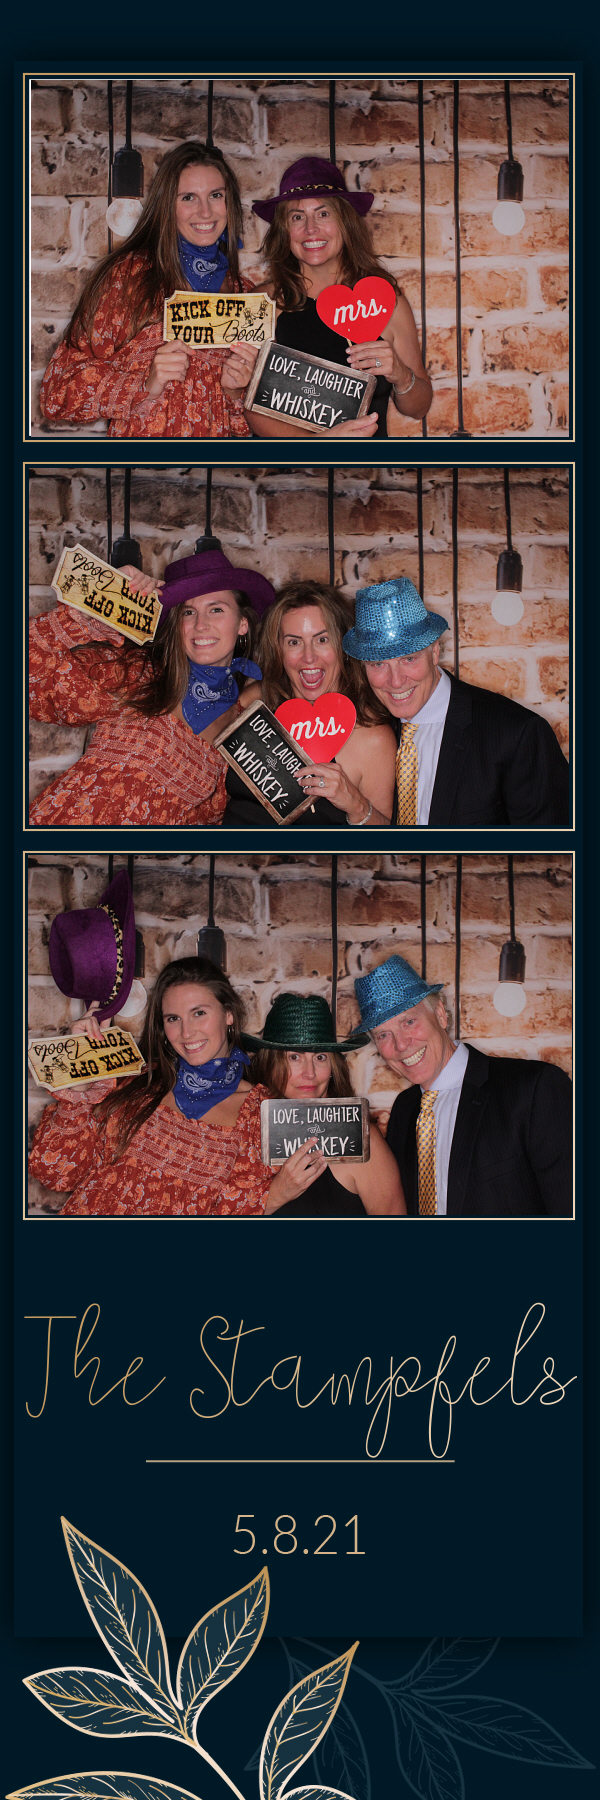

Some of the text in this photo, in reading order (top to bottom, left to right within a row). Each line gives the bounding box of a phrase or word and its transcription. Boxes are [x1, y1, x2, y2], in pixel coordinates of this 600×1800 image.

[169, 299, 246, 323] KICK OFF
[333, 298, 388, 326] mrs.
[171, 319, 266, 345] YOUR Boots
[268, 353, 364, 400] LOVE, LAUGHTER
[301, 384, 320, 398] and
[270, 387, 344, 428] WHISKEY
[71, 551, 124, 600] Boots
[83, 589, 155, 635] KICK OFF
[248, 714, 277, 749] LOVE,
[289, 716, 346, 741] mrs.
[233, 742, 289, 803] WHISKEY
[32, 1038, 98, 1063] Boots
[69, 1046, 140, 1079] KICK OFF
[272, 1106, 361, 1126] LOVE, LAUGHTER
